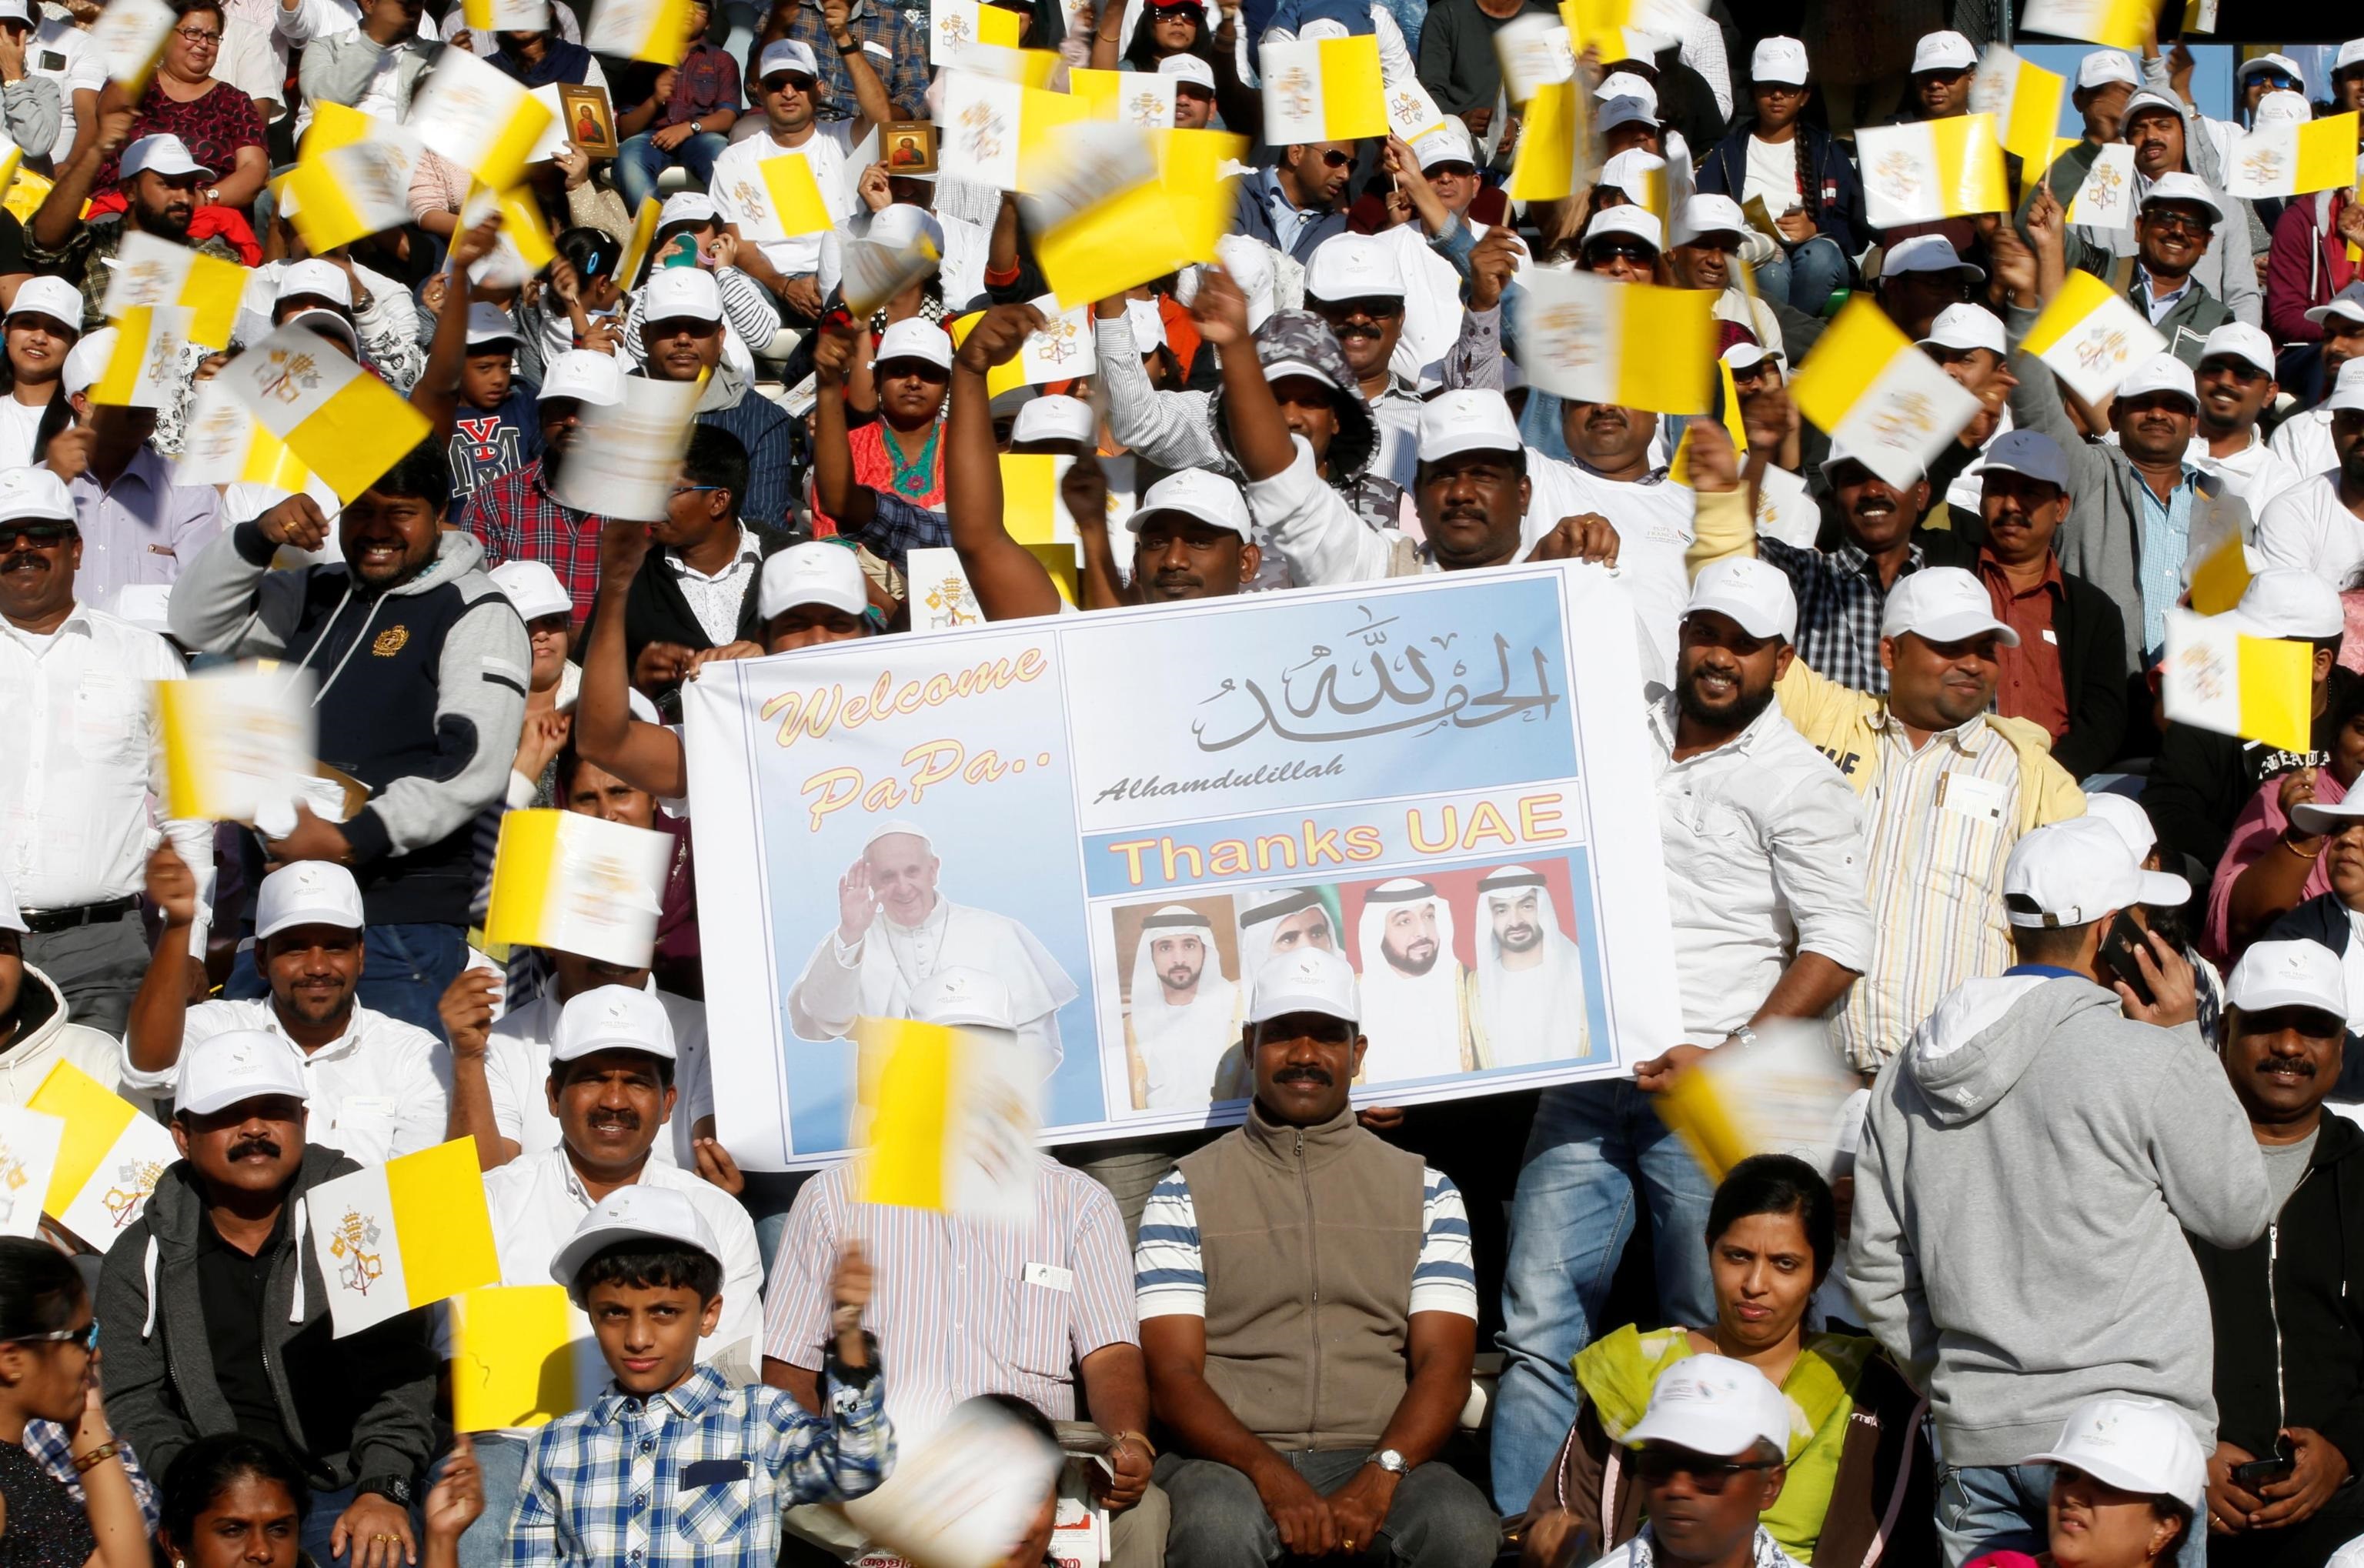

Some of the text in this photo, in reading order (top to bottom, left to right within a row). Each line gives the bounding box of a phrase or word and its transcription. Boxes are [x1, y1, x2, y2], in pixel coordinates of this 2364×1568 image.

[760, 648, 1048, 748] Welcome
[1093, 754, 1346, 806] Alhamdulillah
[1108, 793, 1568, 886] Thanks UAE
